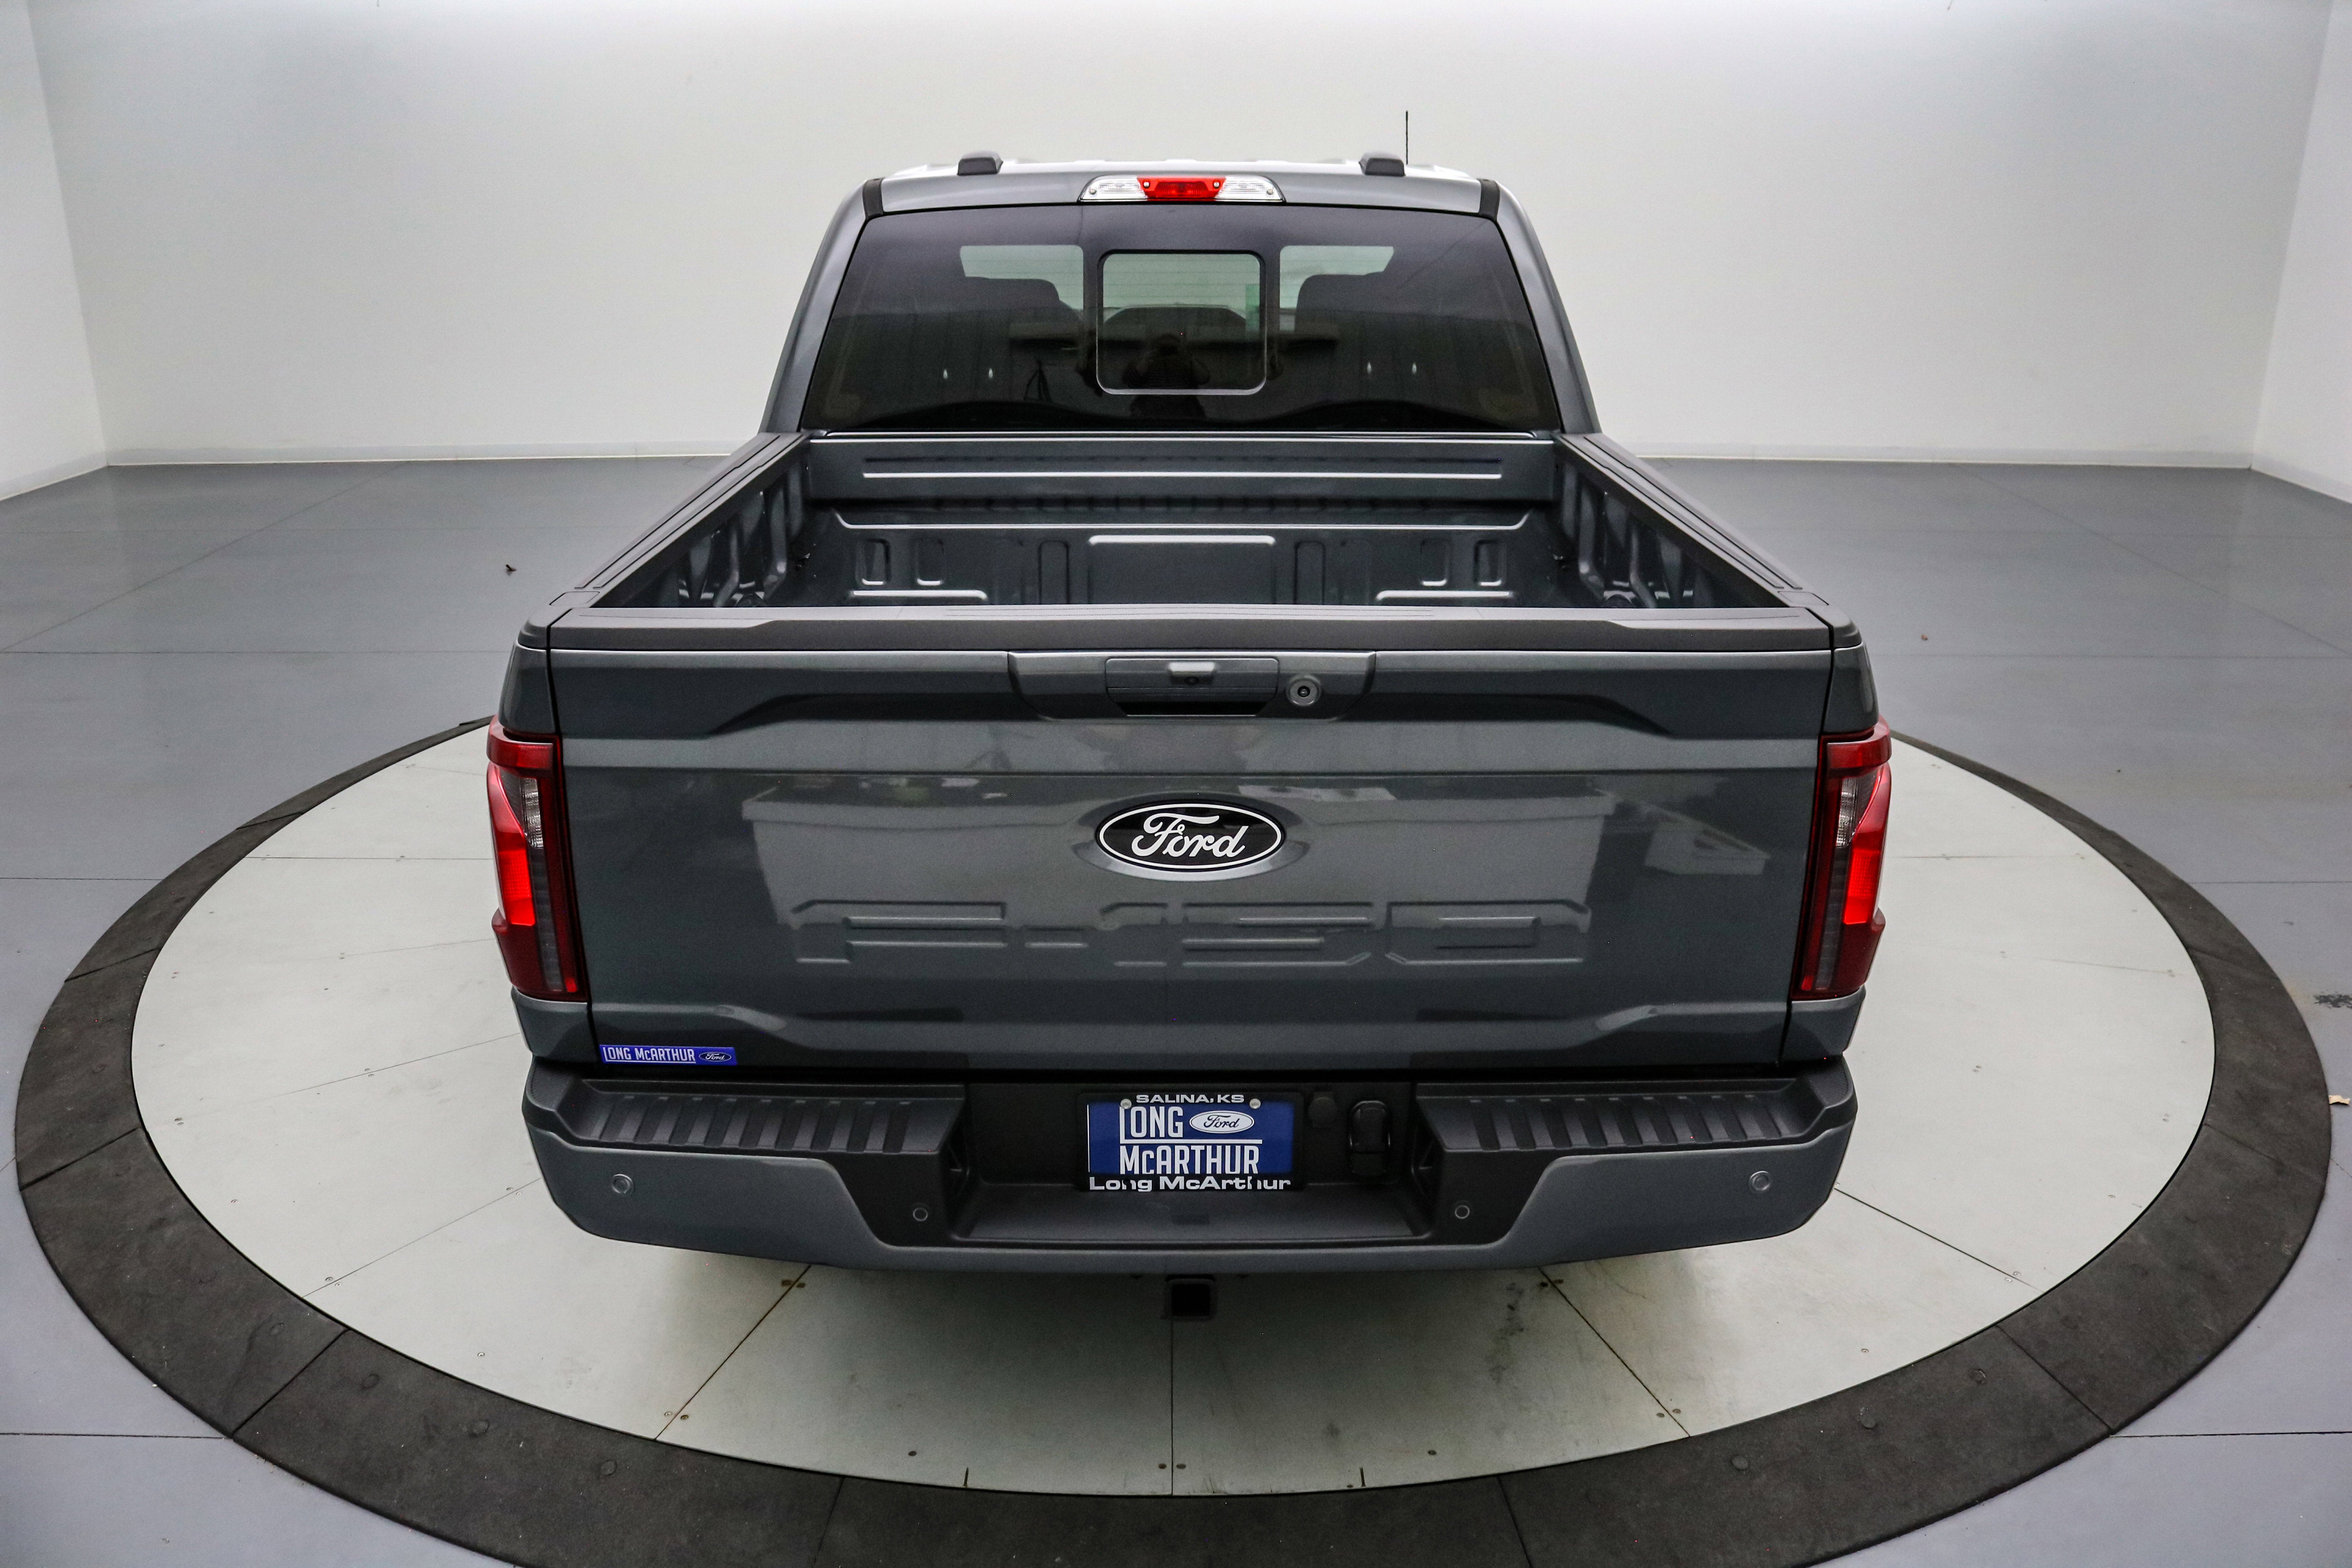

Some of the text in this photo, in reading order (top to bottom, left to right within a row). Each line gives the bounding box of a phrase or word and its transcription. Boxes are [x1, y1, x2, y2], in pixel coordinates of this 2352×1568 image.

[1131, 813, 1249, 857] Ford
[791, 899, 1587, 967] F-150
[603, 1047, 695, 1062] LONG McARTHUR
[1218, 1094, 1244, 1103] KS
[1119, 1106, 1183, 1144] LONG
[1203, 1114, 1239, 1128] Ford
[1120, 1145, 1260, 1174] McARTHUR
[1089, 1176, 1291, 1192] Long McArthur
